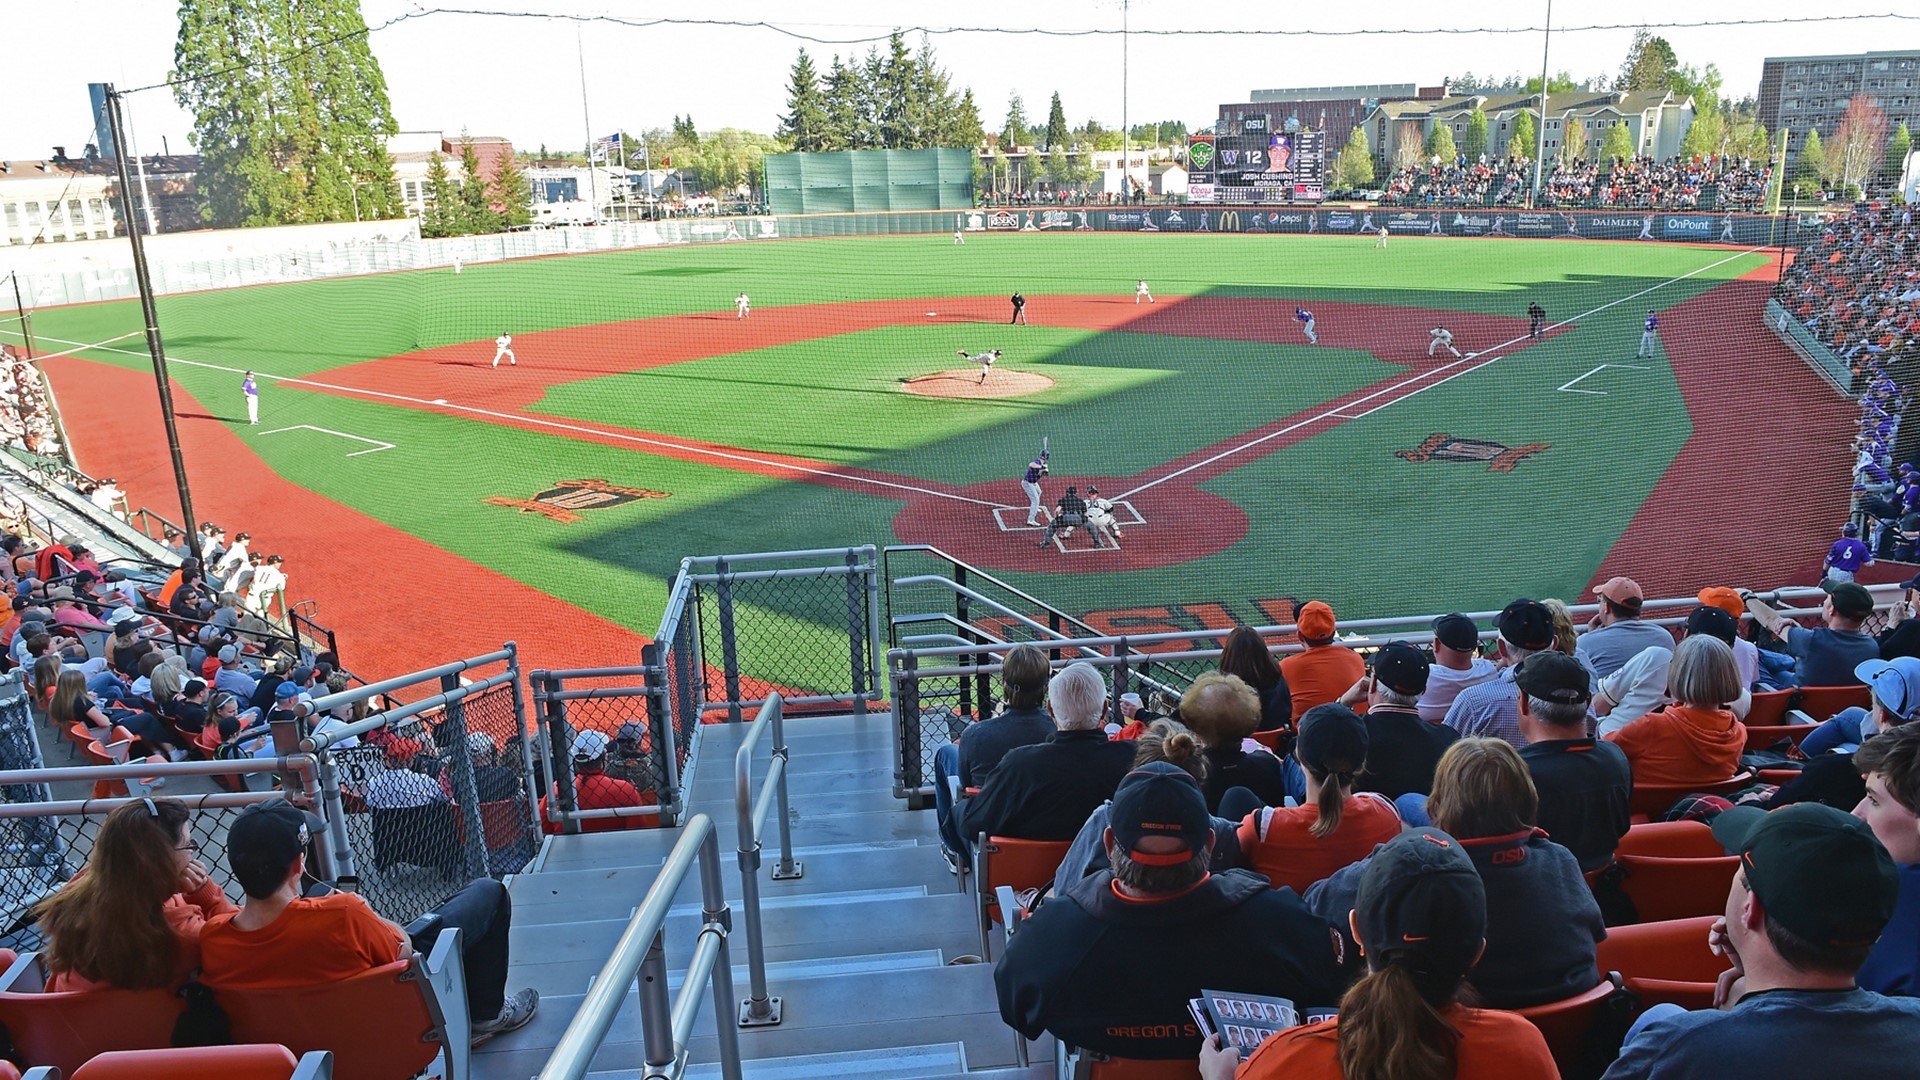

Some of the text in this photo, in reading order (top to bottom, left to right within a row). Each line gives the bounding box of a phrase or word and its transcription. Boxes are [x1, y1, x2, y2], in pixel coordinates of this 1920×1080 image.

[1245, 120, 1265, 129] OSU
[1220, 149, 1240, 165] W
[1245, 150, 1262, 164] 12
[1280, 214, 1303, 224] pepsi
[1592, 218, 1640, 227] DAIMLER
[1668, 218, 1709, 230] OnPoint
[1842, 546, 1853, 559] 6
[259, 571, 271, 584] 11
[334, 750, 382, 764] ECTION
[351, 764, 365, 781] D
[1491, 846, 1527, 865] OSU
[1106, 1024, 1179, 1038] OREGON
